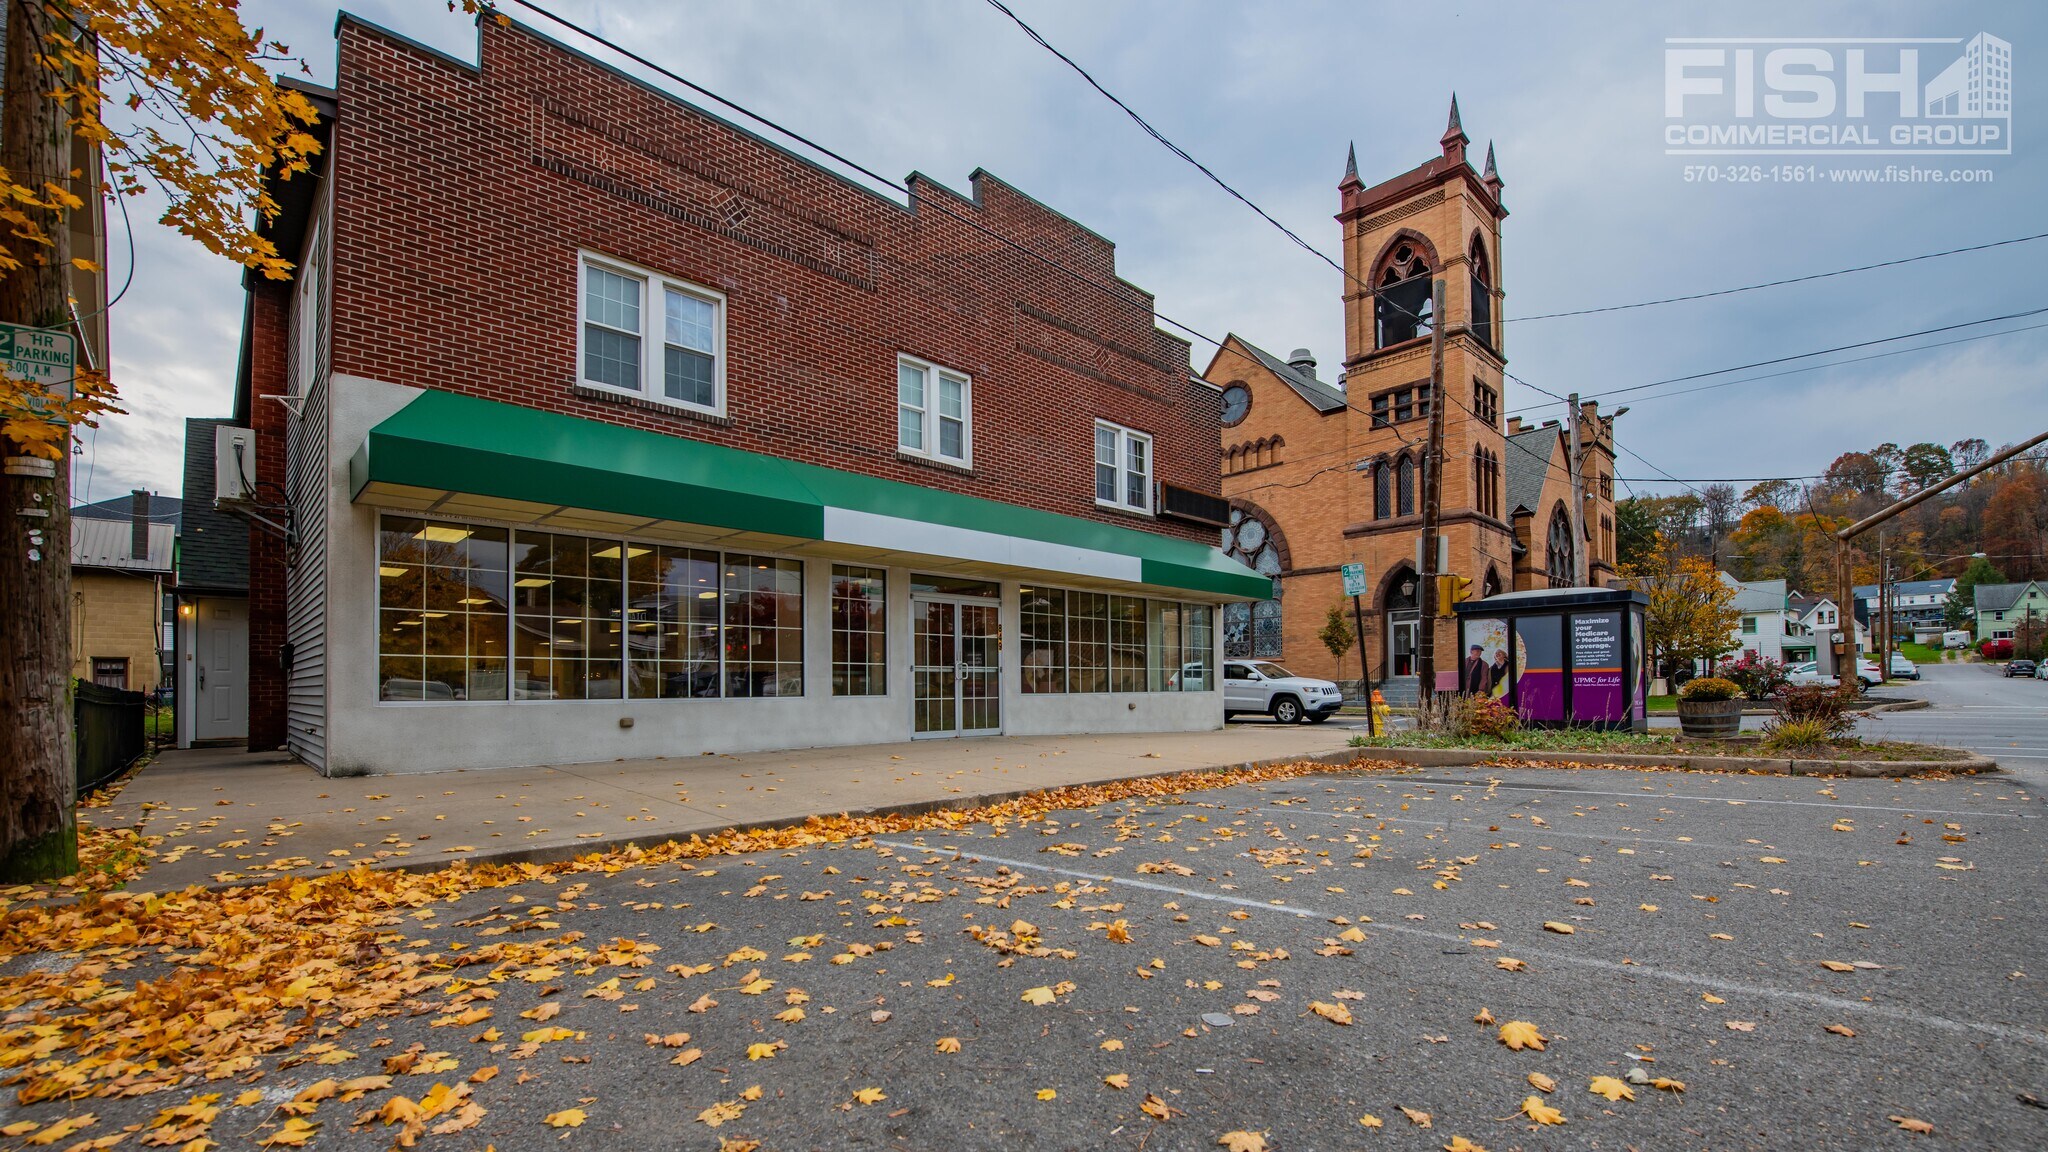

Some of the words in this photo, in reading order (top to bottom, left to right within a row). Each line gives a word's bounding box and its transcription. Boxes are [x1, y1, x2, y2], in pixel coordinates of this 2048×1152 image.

[0, 331, 10, 353] 2
[32, 333, 54, 347] HR
[16, 346, 69, 364] PARKING
[34, 364, 54, 378] A.M.
